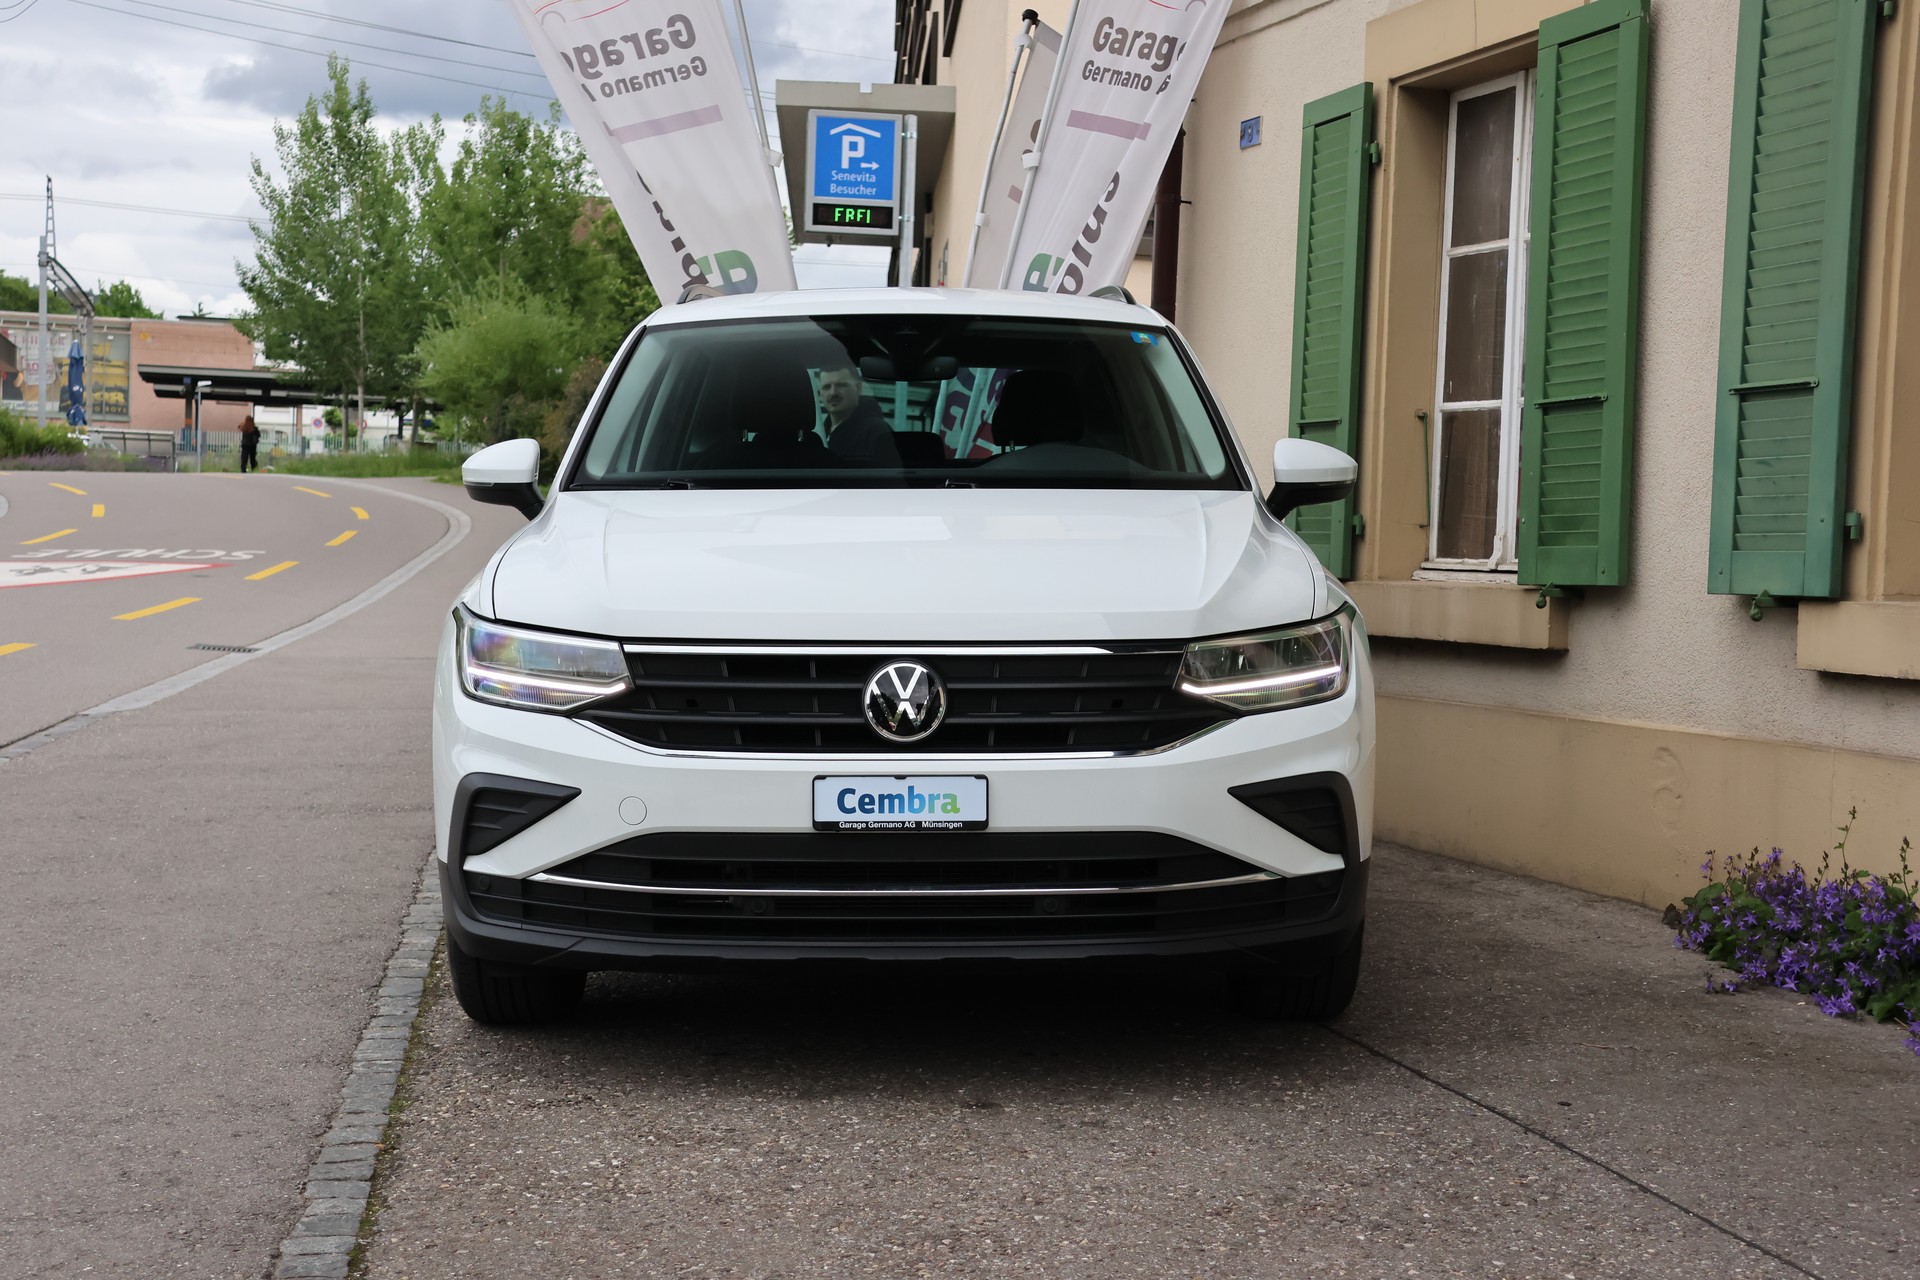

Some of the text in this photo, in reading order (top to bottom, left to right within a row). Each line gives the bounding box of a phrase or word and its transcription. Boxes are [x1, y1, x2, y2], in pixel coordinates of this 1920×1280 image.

[1082, 60, 1153, 92] Germano
[841, 135, 865, 169] P
[831, 170, 876, 183] Senevita
[830, 183, 877, 196] Besucher
[11, 548, 266, 560] SCHULE
[837, 785, 961, 814] Cembra
[839, 821, 867, 829] Garage
[922, 820, 963, 829] Münsingen
